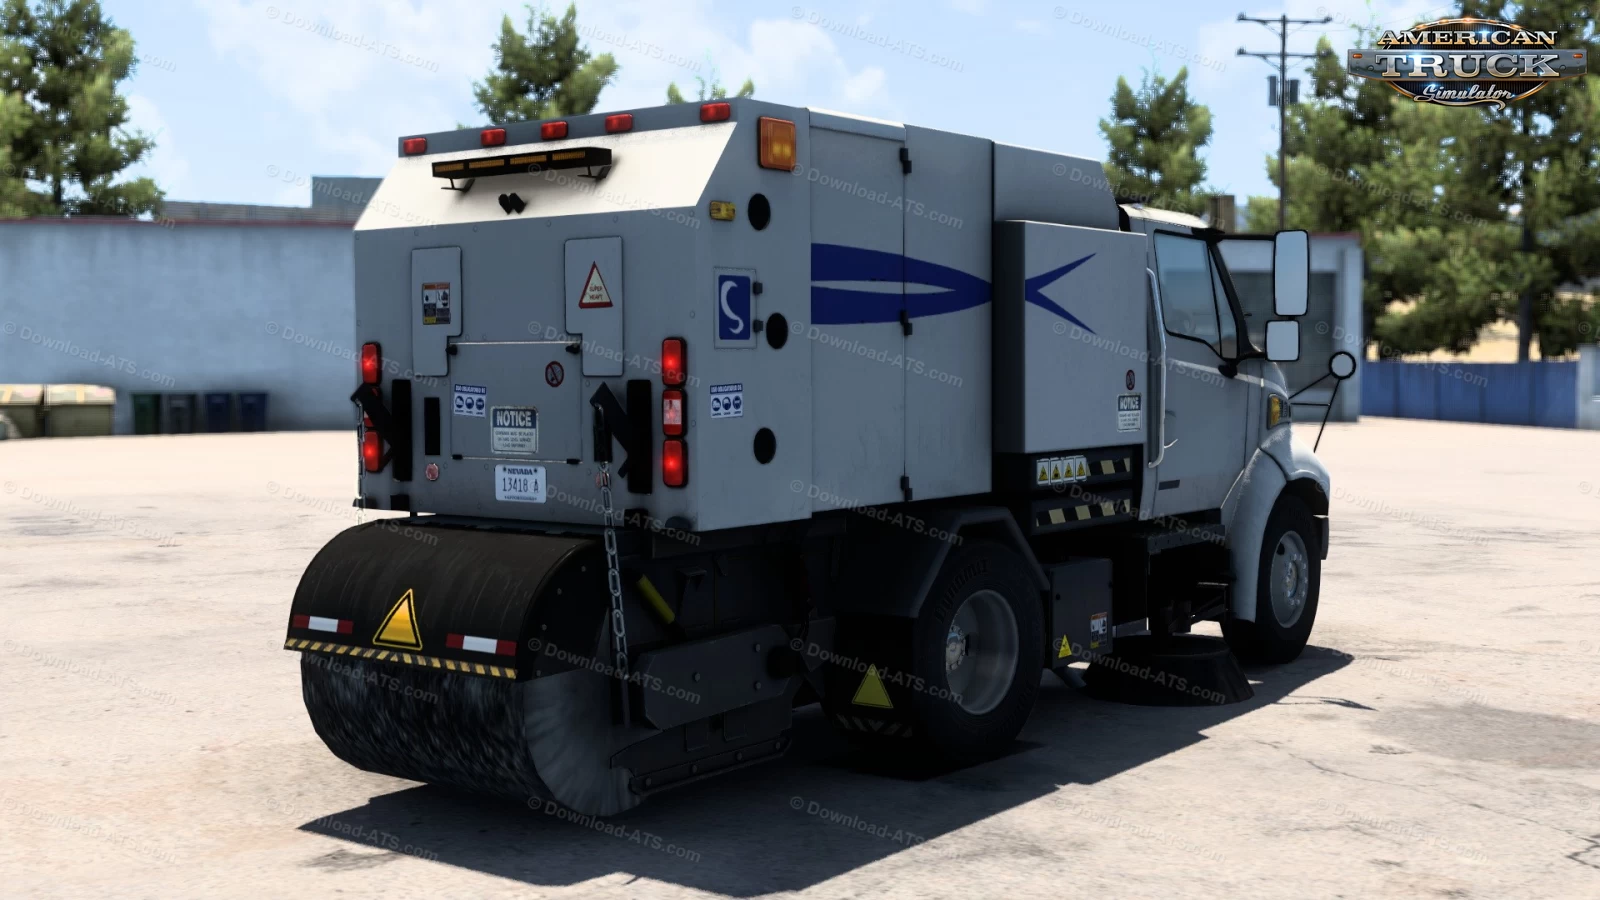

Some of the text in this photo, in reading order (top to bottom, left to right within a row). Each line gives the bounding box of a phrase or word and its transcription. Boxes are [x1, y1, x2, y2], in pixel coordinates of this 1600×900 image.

[1119, 396, 1139, 410] NOTICE
[496, 410, 532, 427] NOTICE
[507, 467, 533, 475] NEVADA
[502, 477, 528, 492] 13418
